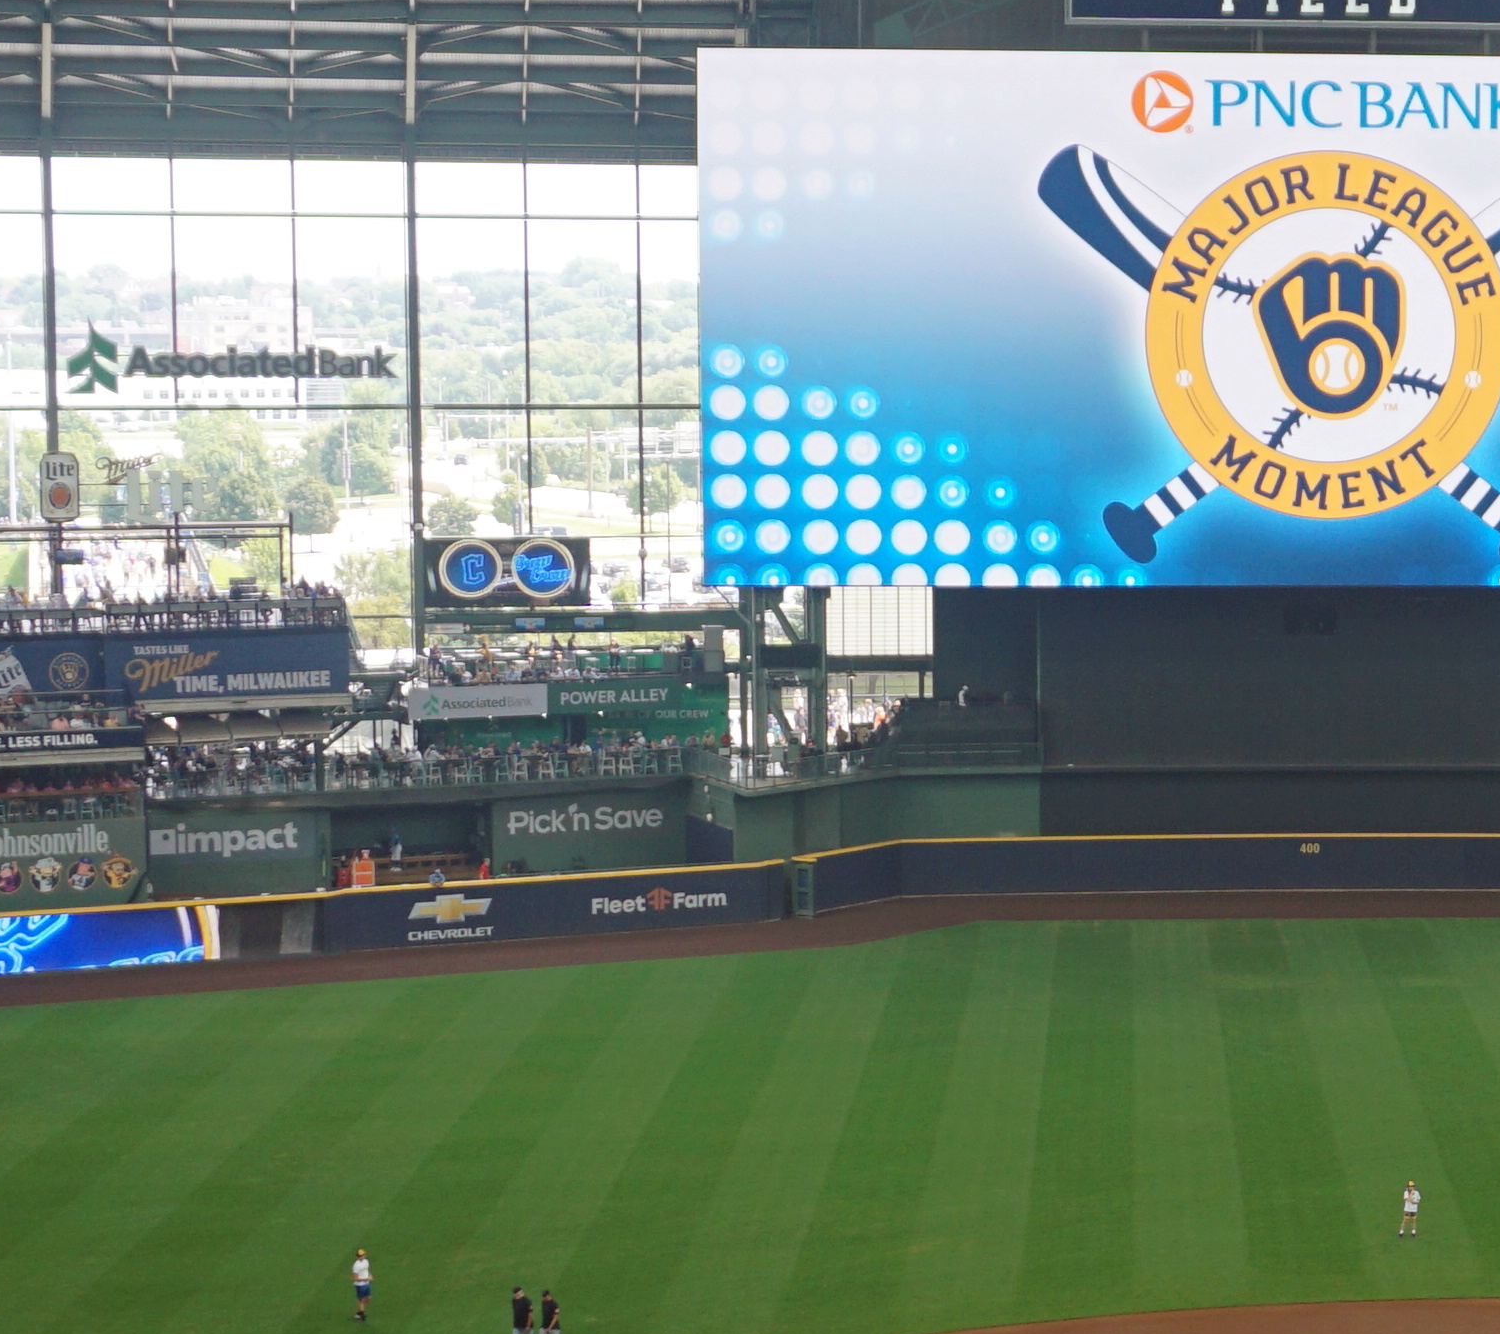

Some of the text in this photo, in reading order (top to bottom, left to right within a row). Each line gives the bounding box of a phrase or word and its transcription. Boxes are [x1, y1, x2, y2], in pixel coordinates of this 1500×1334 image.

[1206, 79, 1342, 130] PNC
[1160, 162, 1500, 308] MAJOR LEAGUE
[124, 345, 397, 380] Associated Bank
[44, 460, 75, 480] Lite
[1208, 437, 1437, 511] MOMENT
[133, 644, 191, 656] TASTES LIKE
[123, 650, 219, 692] Miller
[172, 669, 331, 694] TIME, MILWAUKEE
[441, 694, 533, 710] Associated Bank
[559, 687, 669, 706] POWER ALLEY
[176, 822, 299, 857] impact
[1299, 841, 1321, 855] 400
[591, 889, 728, 915] Fleet Farm
[407, 925, 494, 942] CHEVROLET
